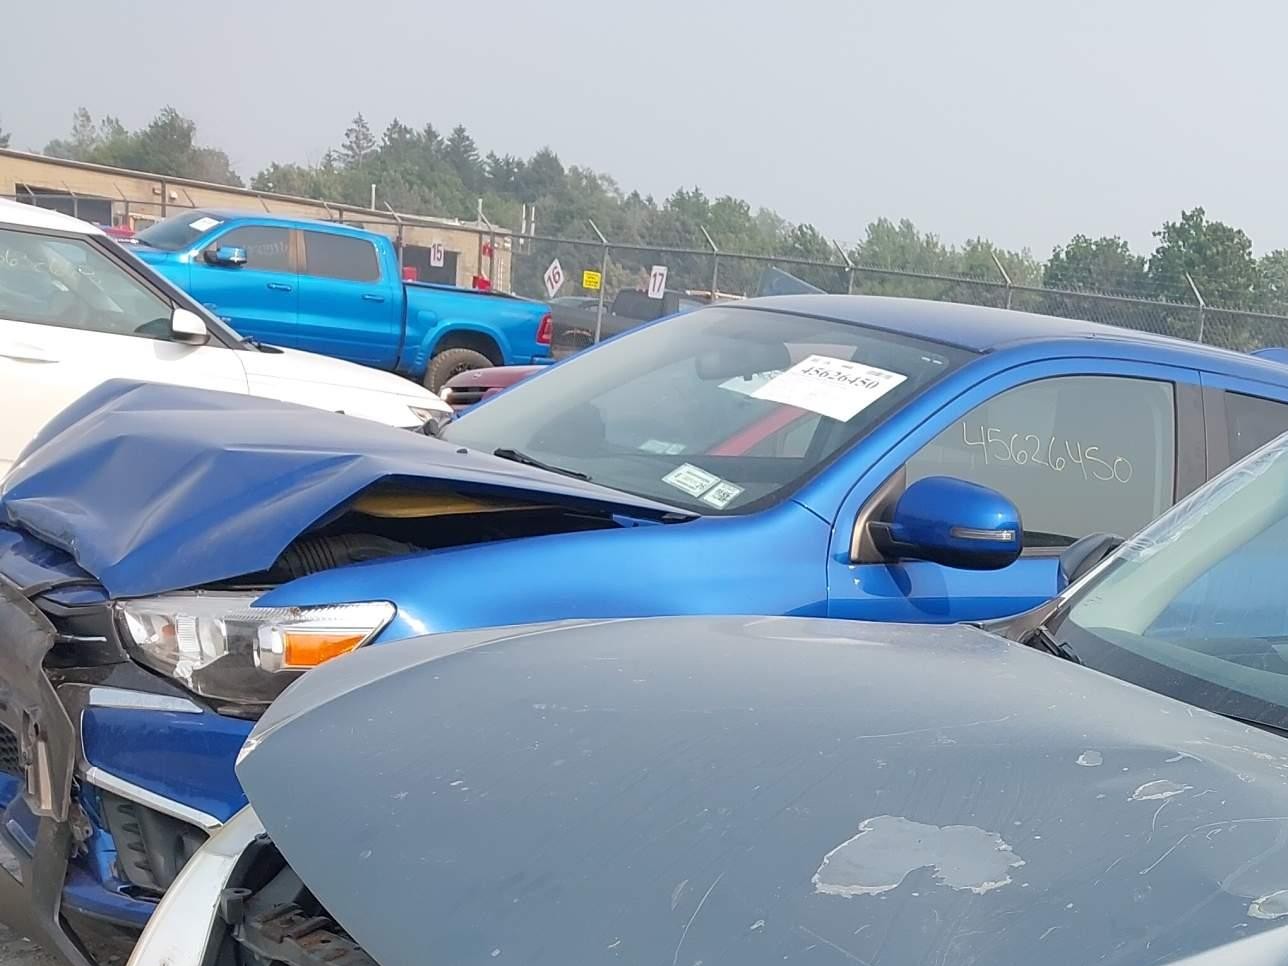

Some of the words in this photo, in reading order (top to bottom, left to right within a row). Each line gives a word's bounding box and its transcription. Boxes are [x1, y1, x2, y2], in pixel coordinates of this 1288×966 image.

[431, 243, 443, 263] 15
[546, 265, 562, 291] 16
[652, 271, 665, 293] 17
[800, 366, 879, 390] 45626450
[962, 421, 1133, 484] 45626450
